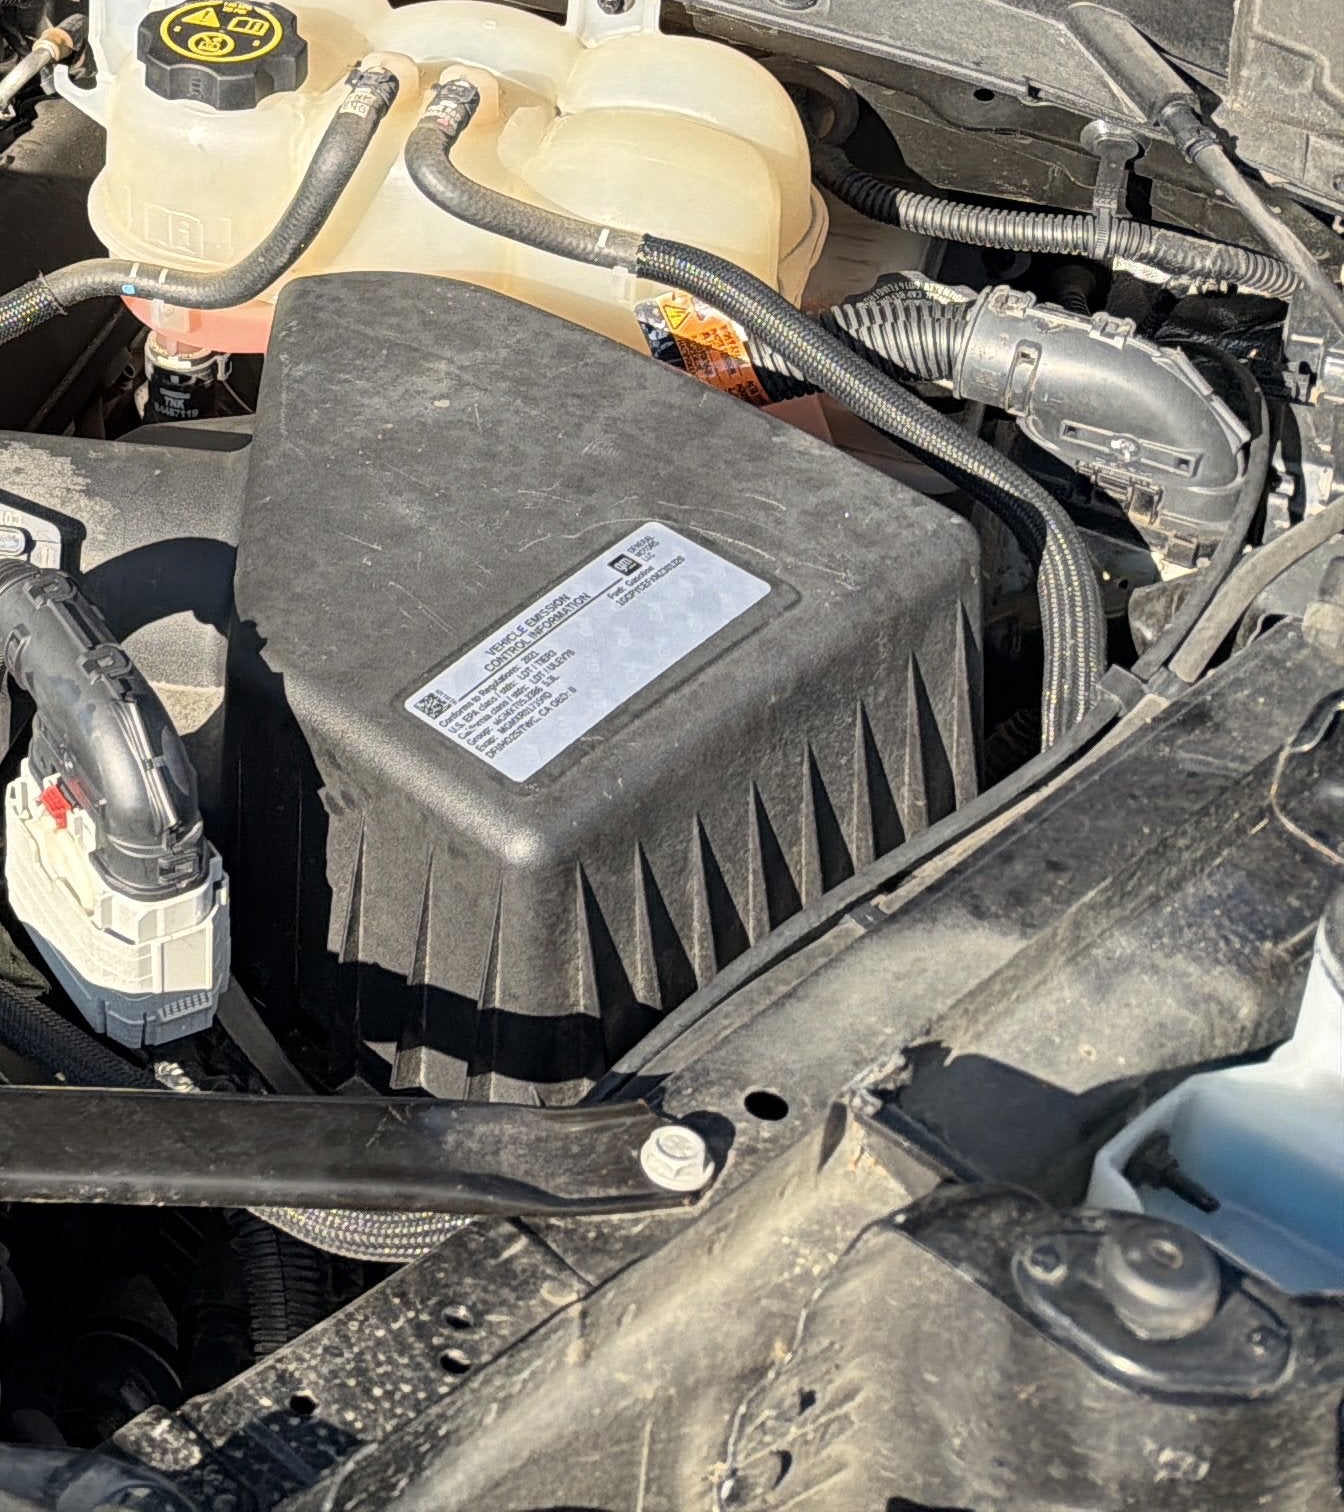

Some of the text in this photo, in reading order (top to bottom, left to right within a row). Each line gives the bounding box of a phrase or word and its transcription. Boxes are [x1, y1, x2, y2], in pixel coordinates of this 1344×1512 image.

[484, 592, 592, 672] CONTROL INFORMATION
[485, 593, 571, 656] VEHICLE EMISSION
